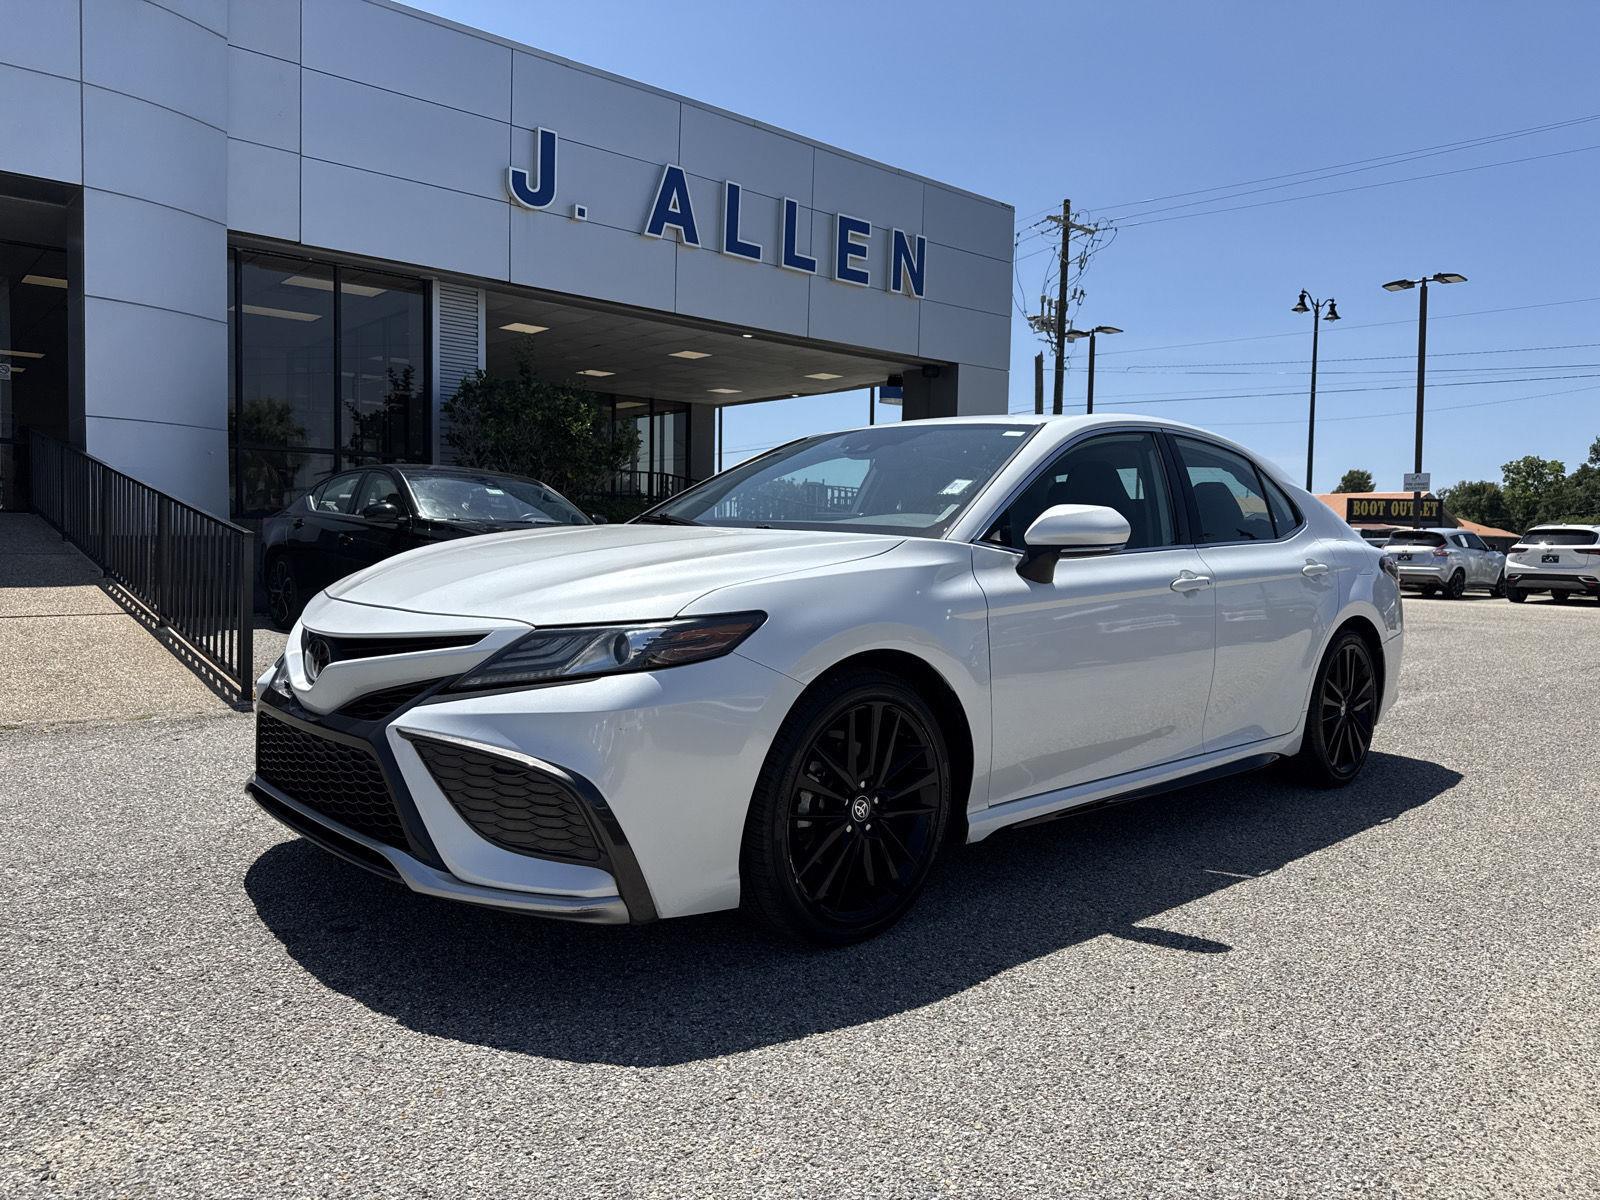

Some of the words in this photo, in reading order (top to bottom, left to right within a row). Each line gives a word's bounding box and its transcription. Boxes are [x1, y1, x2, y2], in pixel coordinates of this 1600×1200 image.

[508, 127, 588, 221] J.
[643, 163, 928, 299] ALLEN
[1353, 500, 1386, 516] BOOT
[1391, 500, 1439, 517] OUTET
